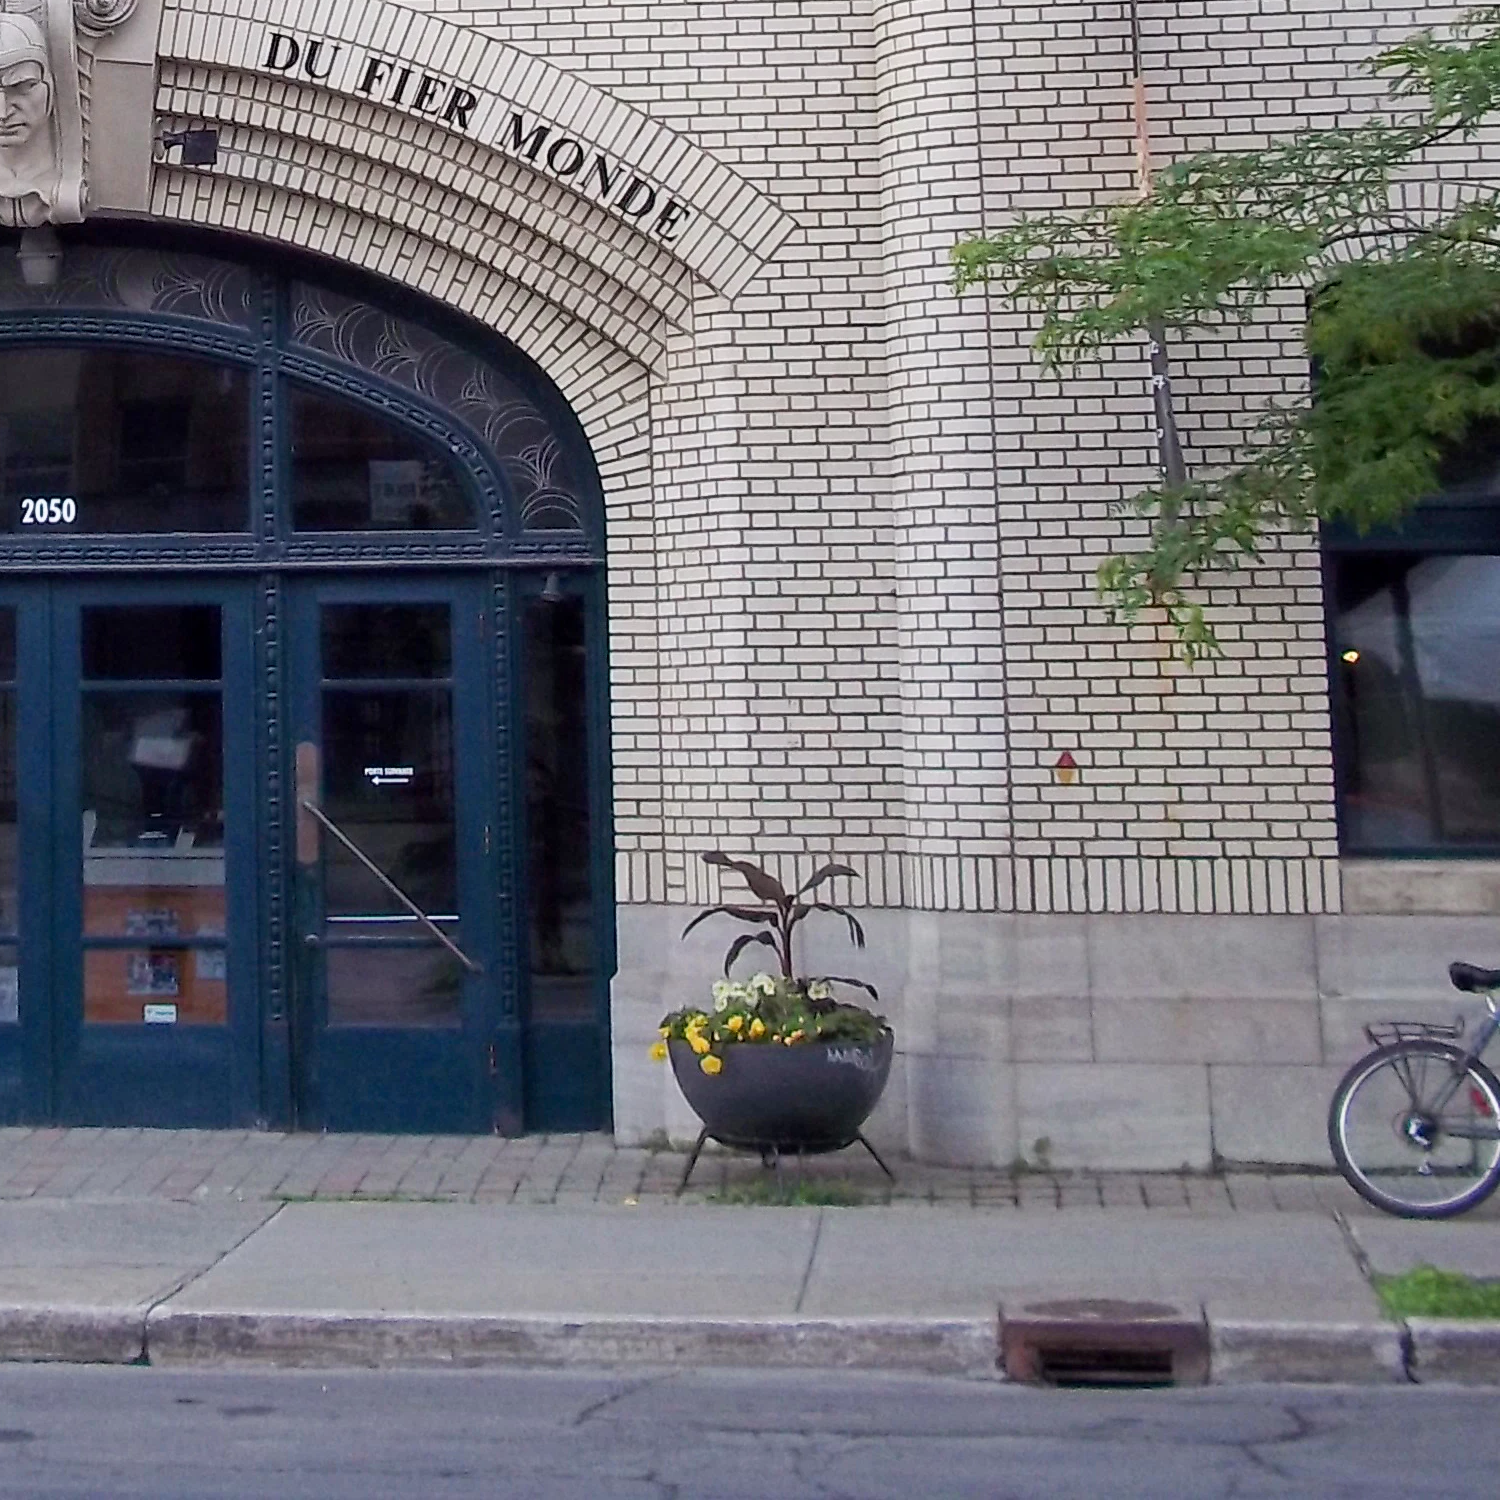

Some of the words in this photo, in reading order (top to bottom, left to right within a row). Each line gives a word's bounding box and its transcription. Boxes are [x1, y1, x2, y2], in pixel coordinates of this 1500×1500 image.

[263, 32, 342, 79] DU
[357, 55, 479, 131] FIER
[496, 112, 691, 243] MONDE
[21, 498, 76, 523] 2050
